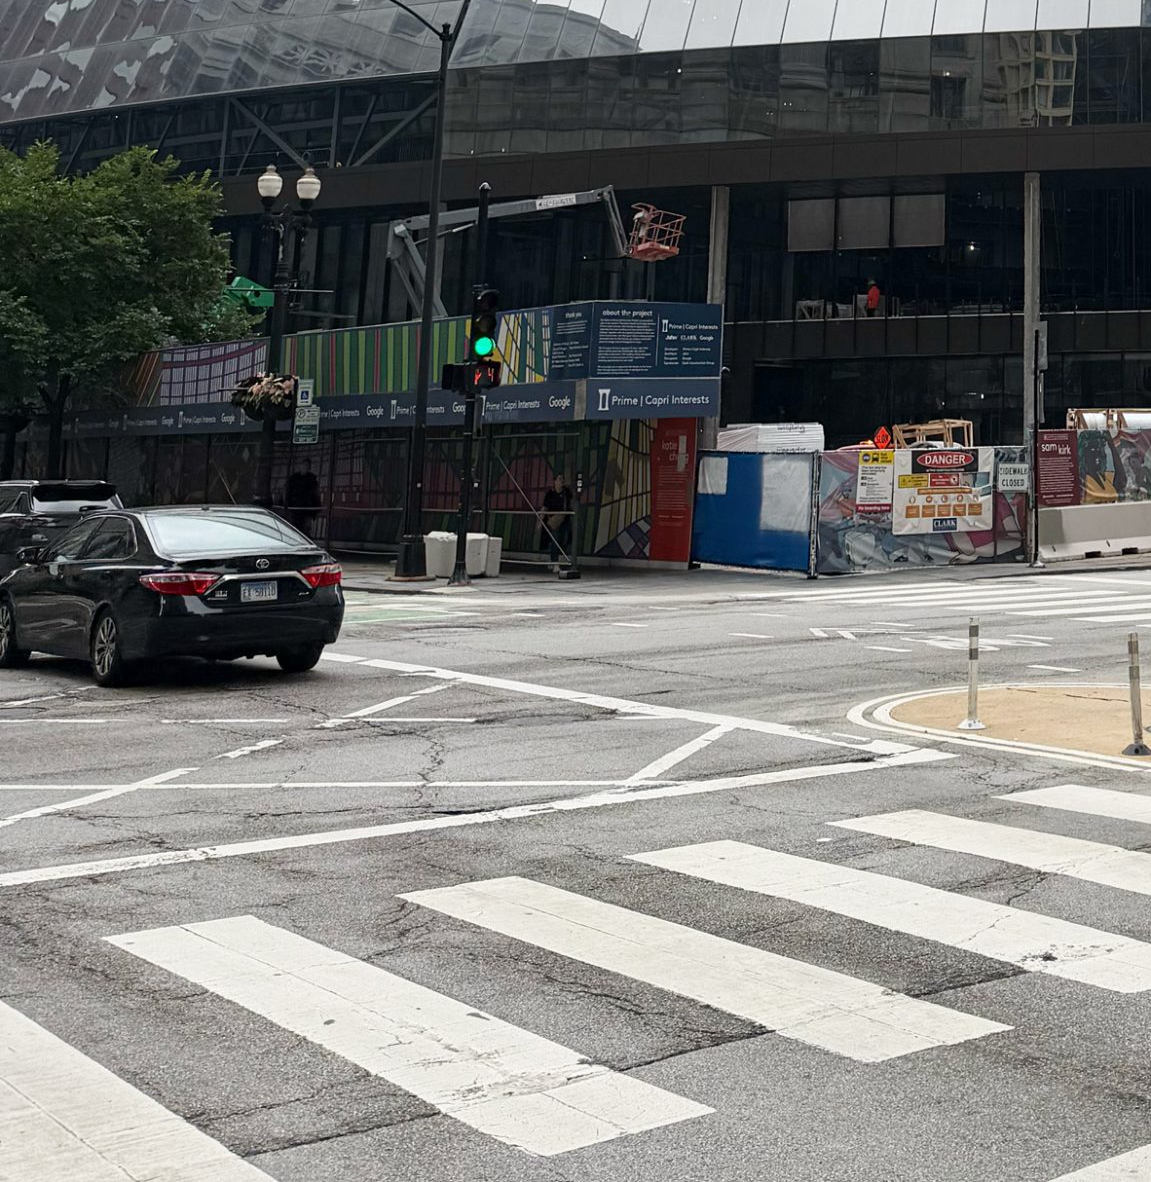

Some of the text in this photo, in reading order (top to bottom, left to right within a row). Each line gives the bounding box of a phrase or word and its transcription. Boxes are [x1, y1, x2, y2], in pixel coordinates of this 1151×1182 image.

[632, 310, 653, 318] project
[486, 400, 540, 412] Prime Capri Interests
[549, 396, 571, 410] Google
[612, 395, 710, 407] Prime Capri Interests
[366, 406, 384, 418] Google
[397, 407, 410, 415] Prime
[221, 413, 235, 423] Google
[1041, 444, 1072, 455] sam kirk
[924, 454, 966, 465] DANGER
[1000, 467, 1028, 475] SIDEWALK
[1002, 479, 1025, 487] CLOSED
[933, 519, 956, 527] CLARK
